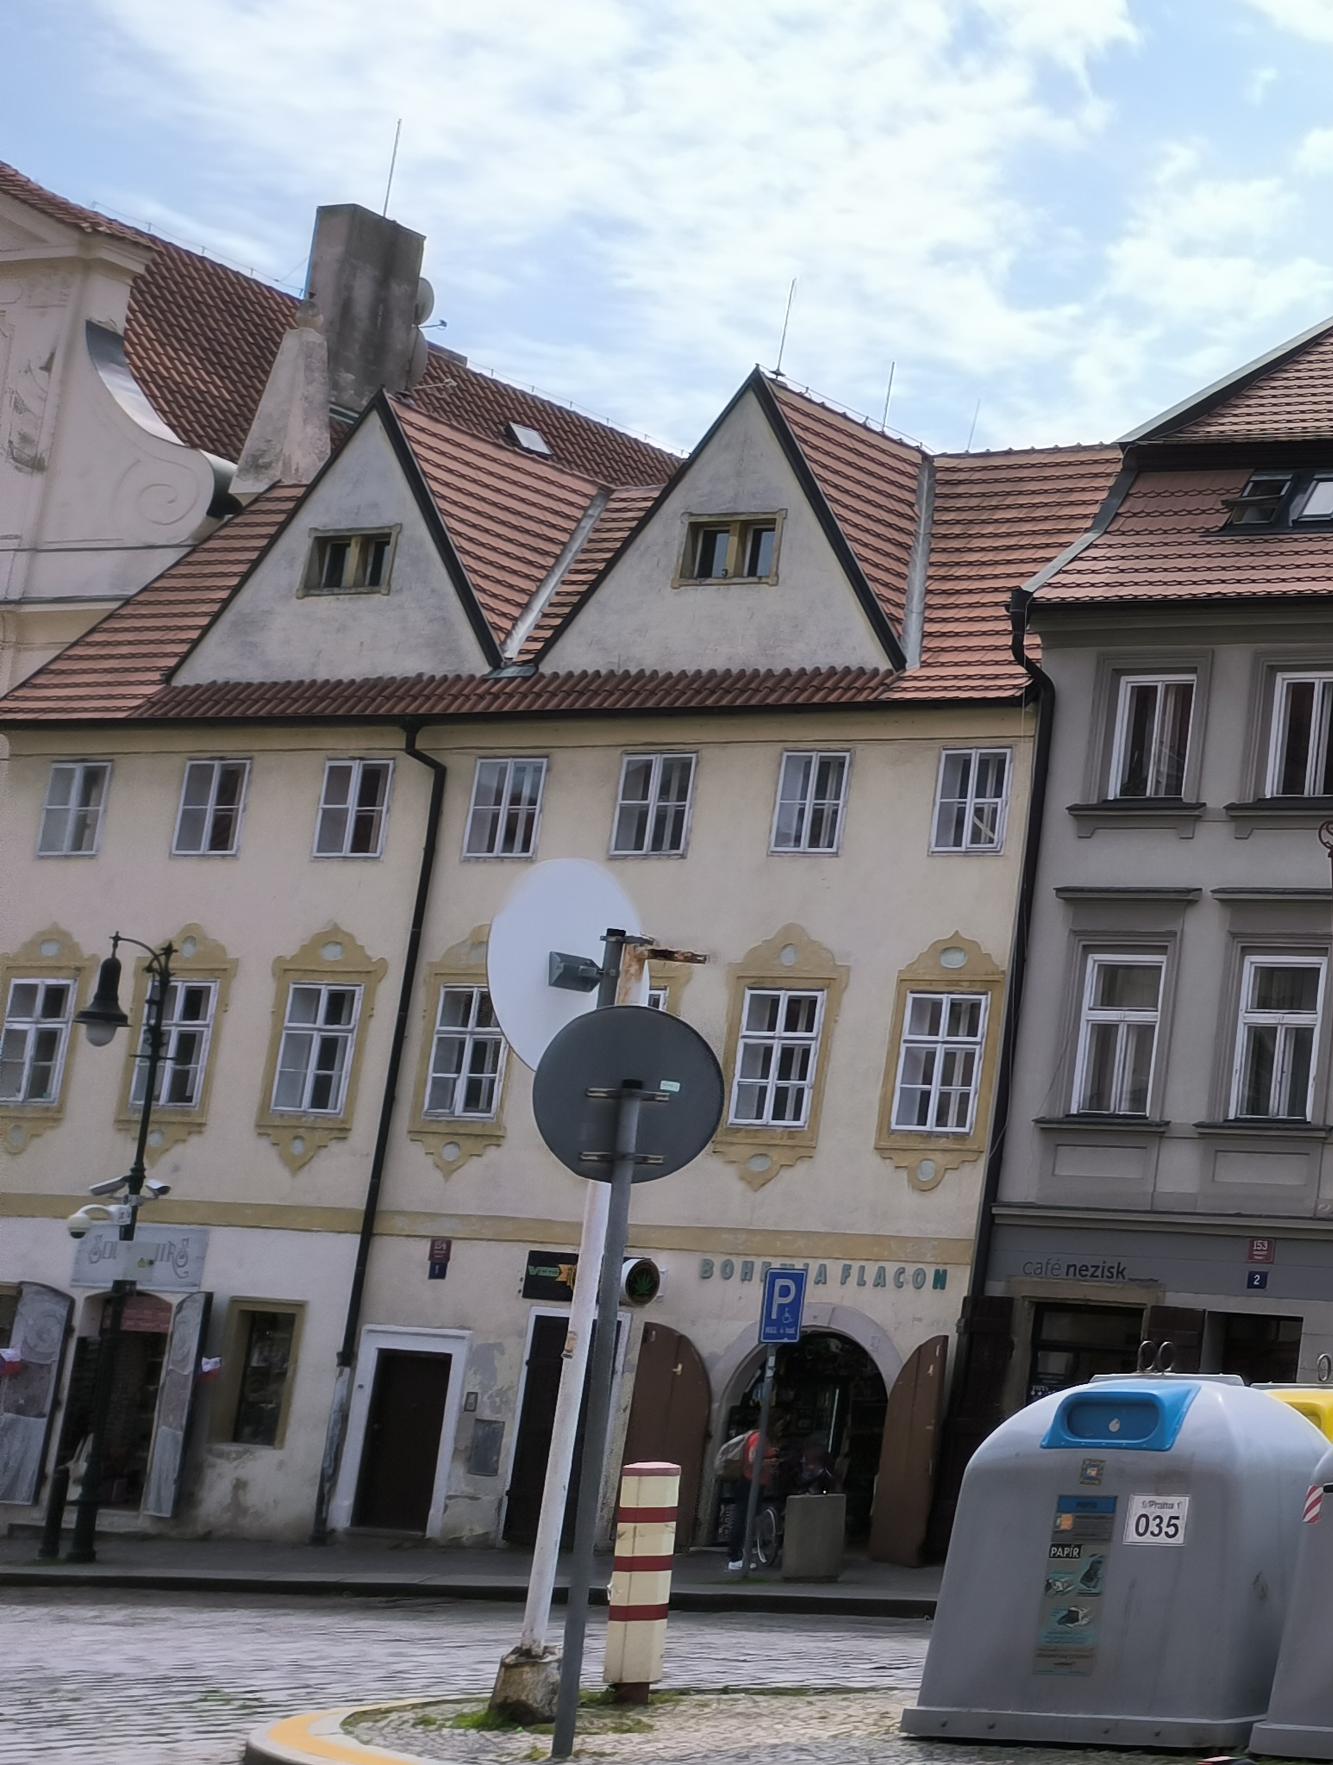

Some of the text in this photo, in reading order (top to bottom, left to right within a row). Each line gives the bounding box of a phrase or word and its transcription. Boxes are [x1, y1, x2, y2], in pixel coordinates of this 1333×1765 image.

[1253, 1240, 1268, 1250] 153
[840, 1263, 948, 1291] FLACON
[1022, 1257, 1127, 1281] café nezisk
[1253, 1274, 1260, 1285] 2
[771, 1278, 796, 1319] P
[1134, 1512, 1181, 1539] 035
